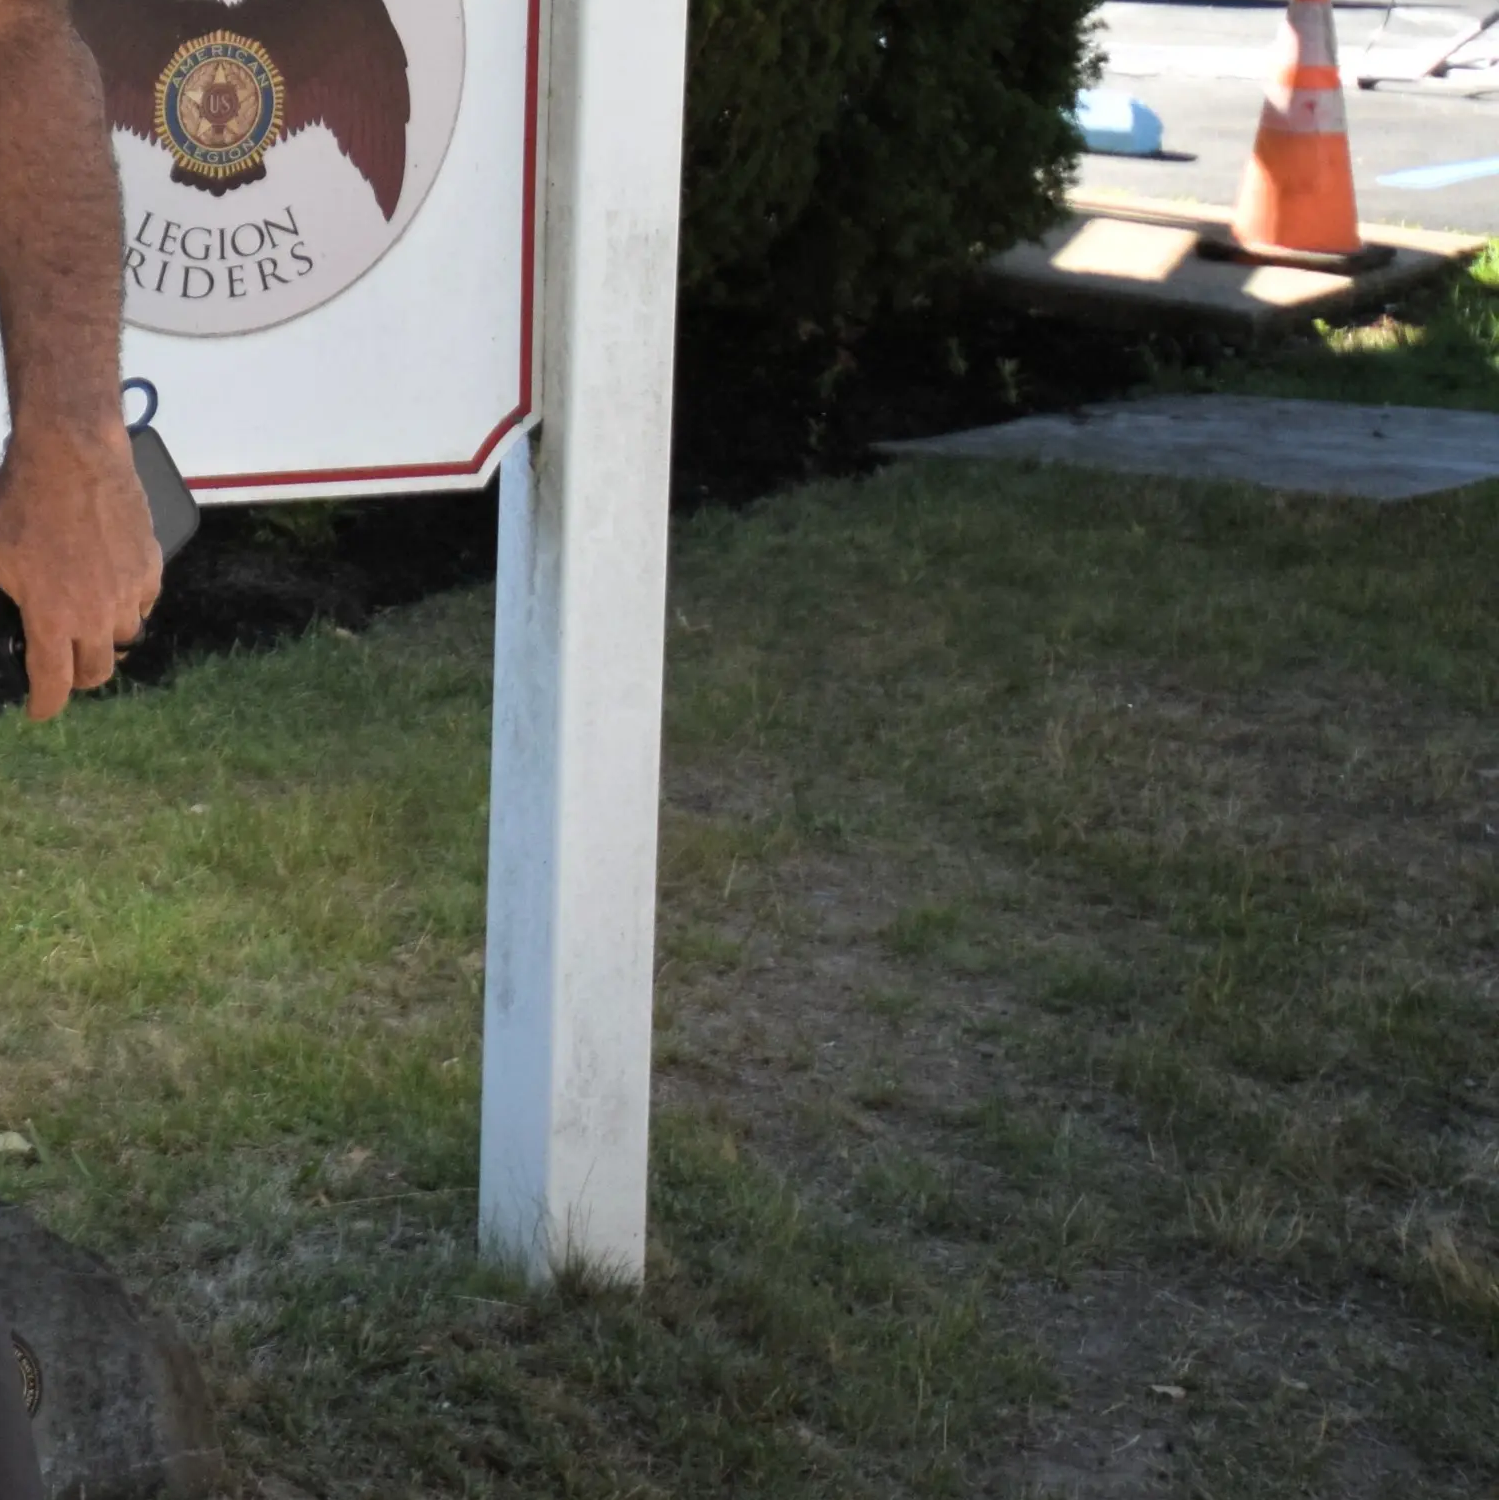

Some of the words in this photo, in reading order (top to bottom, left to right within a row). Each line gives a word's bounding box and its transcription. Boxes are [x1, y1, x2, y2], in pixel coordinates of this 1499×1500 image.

[171, 44, 270, 88] AMERICAN
[209, 94, 231, 114] US
[183, 138, 254, 163] LEGION
[133, 205, 300, 261] LEGION
[124, 240, 315, 299] RIDERS
